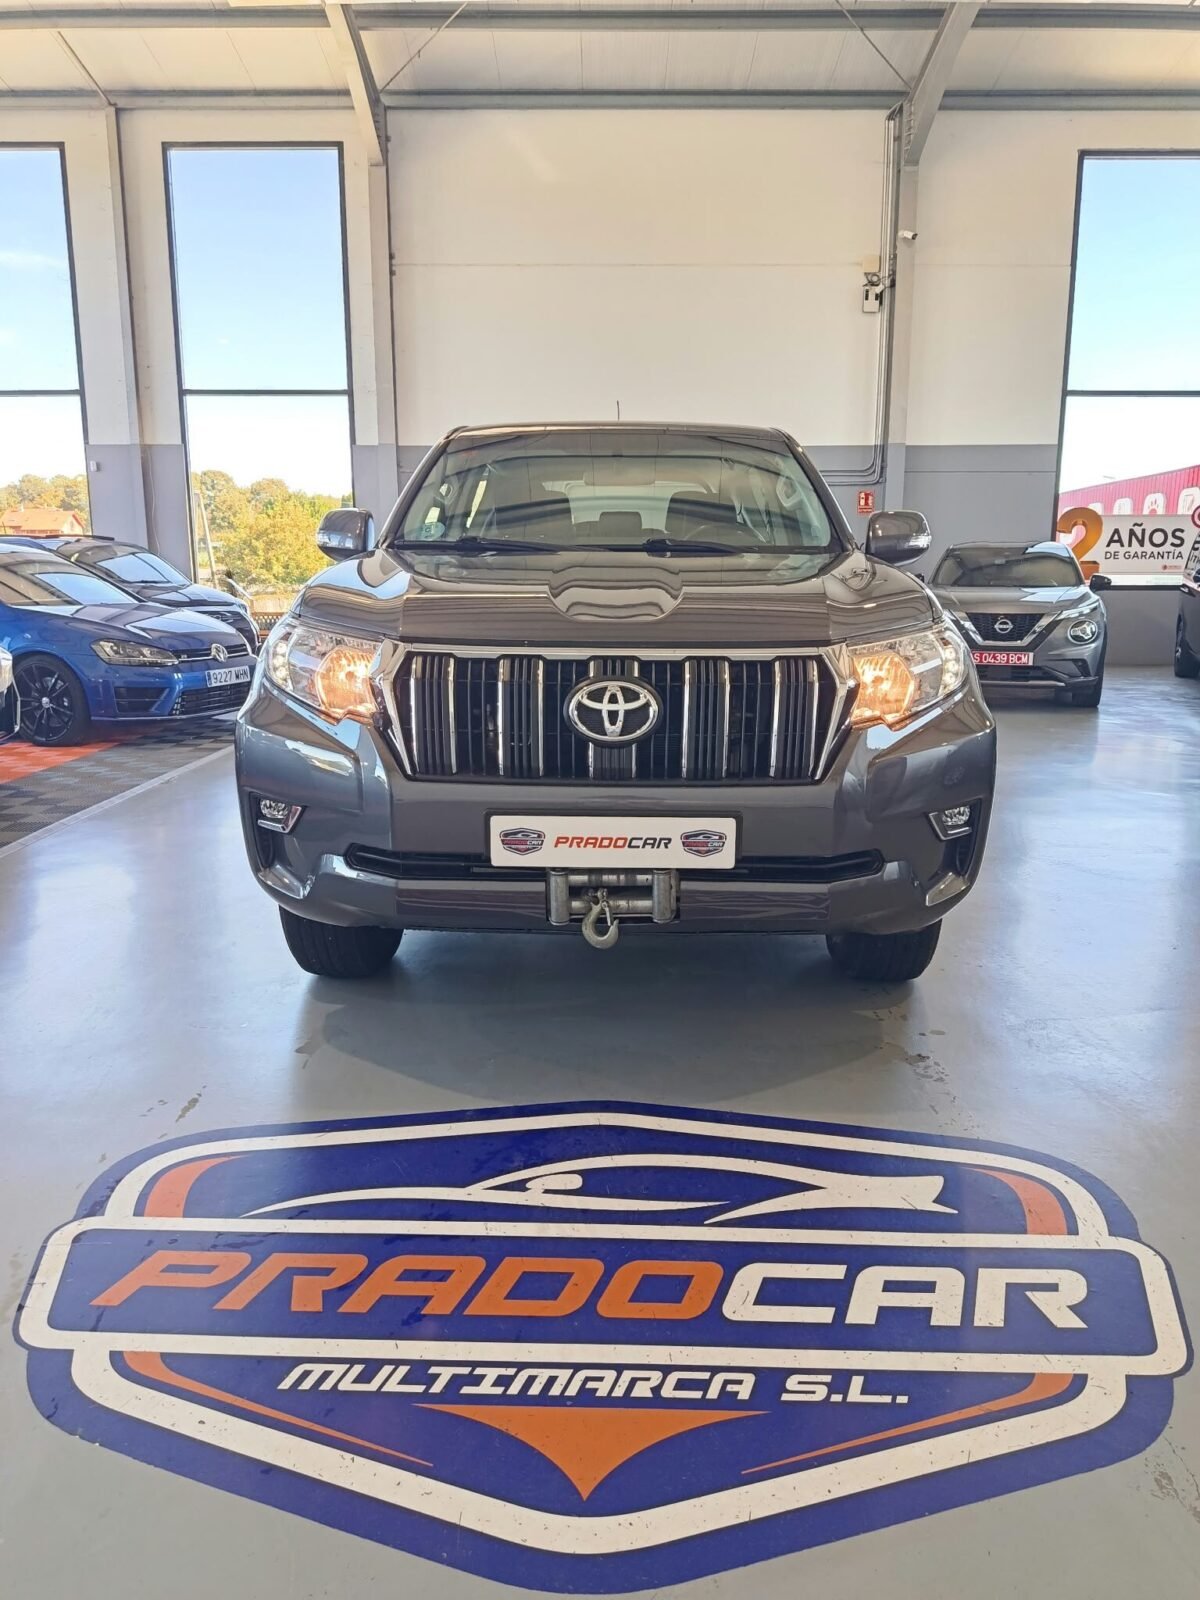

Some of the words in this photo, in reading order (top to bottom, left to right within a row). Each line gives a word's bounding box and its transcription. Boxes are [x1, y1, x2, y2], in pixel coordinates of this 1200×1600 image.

[1057, 507, 1103, 581] 2
[1105, 522, 1185, 548] AÑOS
[1104, 551, 1119, 560] DE
[1123, 549, 1184, 560] GARANTÍA
[982, 653, 1007, 664] 0439
[1009, 653, 1028, 664] BCM
[212, 671, 232, 684] 9227
[554, 836, 673, 849] PRADOCAR
[89, 1250, 1088, 1328] PRADOCAR
[277, 1363, 756, 1401] MULTIMARCA
[780, 1375, 909, 1404] S.L.
